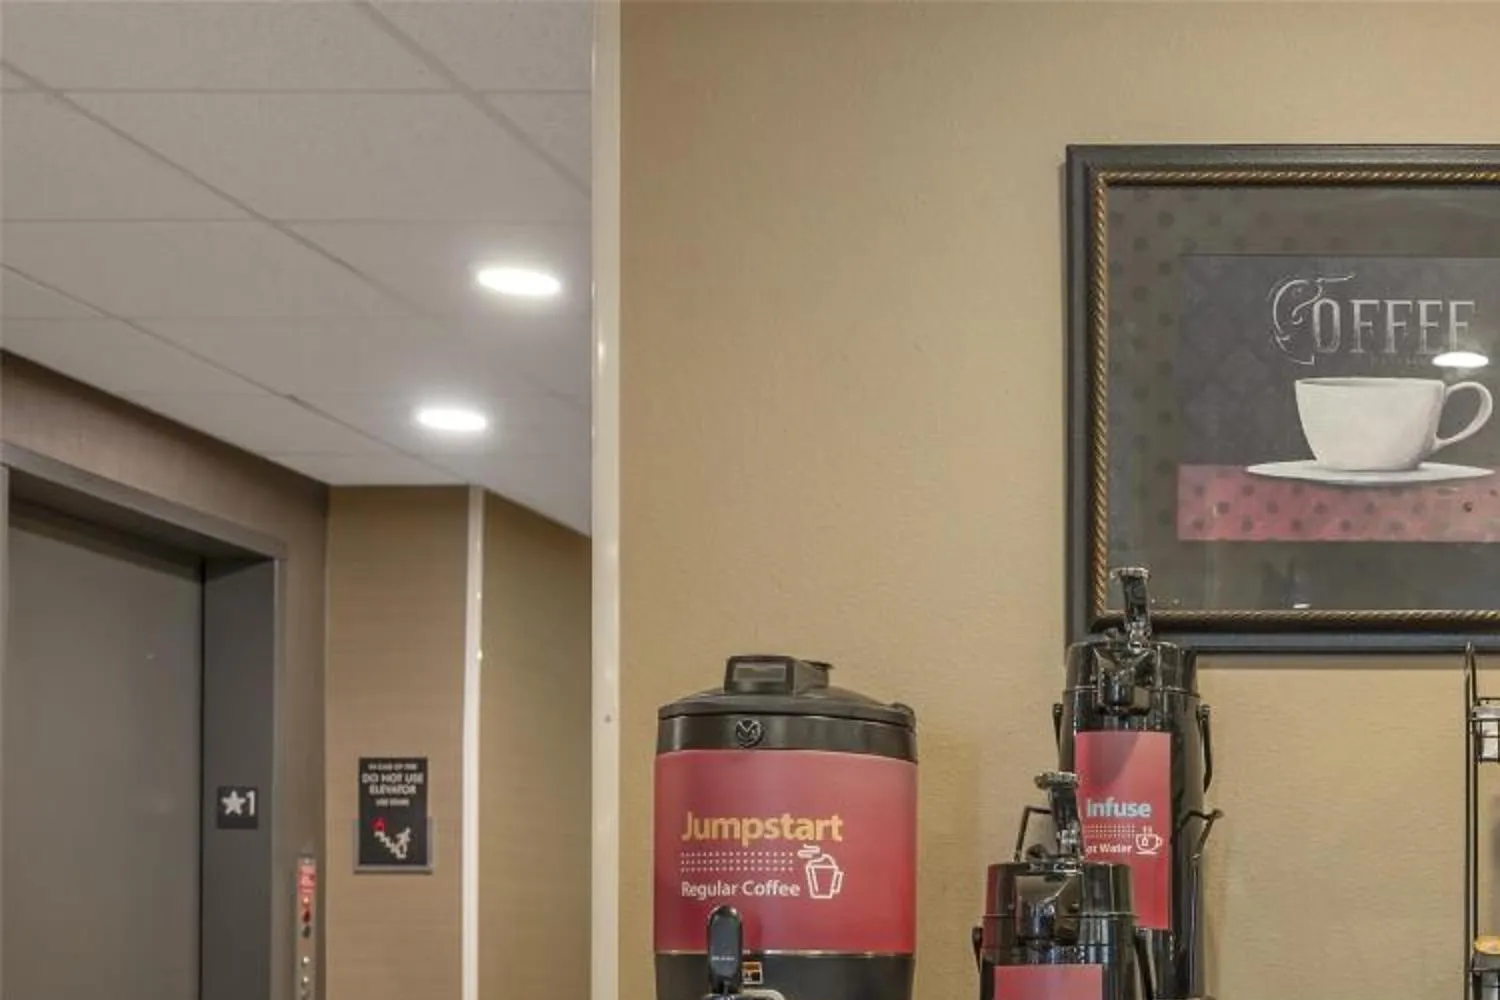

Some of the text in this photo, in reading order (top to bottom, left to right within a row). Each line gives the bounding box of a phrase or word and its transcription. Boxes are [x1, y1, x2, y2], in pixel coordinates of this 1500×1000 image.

[1272, 274, 1475, 365] COFFEE
[361, 773, 423, 784] DO NOT USE
[369, 784, 416, 796] ELEVATOR
[245, 790, 256, 816] 1
[1087, 797, 1152, 817] Infuse
[681, 811, 844, 848] Jumpstart
[1100, 843, 1133, 854] Water
[681, 880, 801, 900] Regular Coffee
